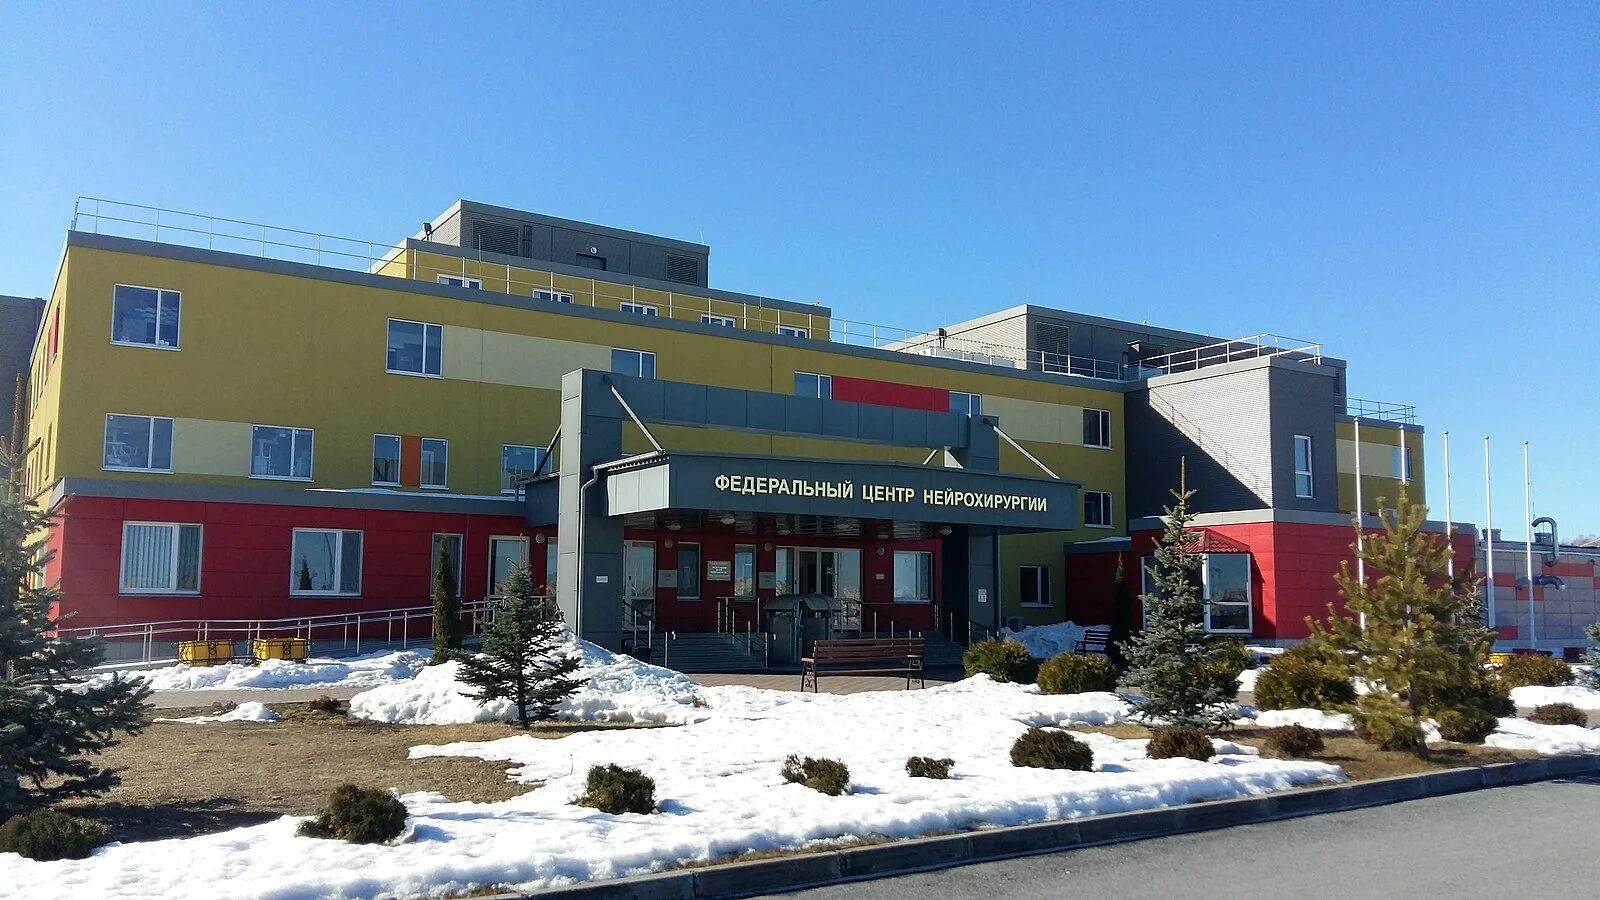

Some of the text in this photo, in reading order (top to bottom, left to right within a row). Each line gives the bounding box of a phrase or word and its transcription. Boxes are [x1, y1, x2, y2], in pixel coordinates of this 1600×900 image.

[714, 474, 1047, 512] ФЕДЕРАЛЬНЫЙ ЦЕНТР НЕЙРОХИРУРГИИ
